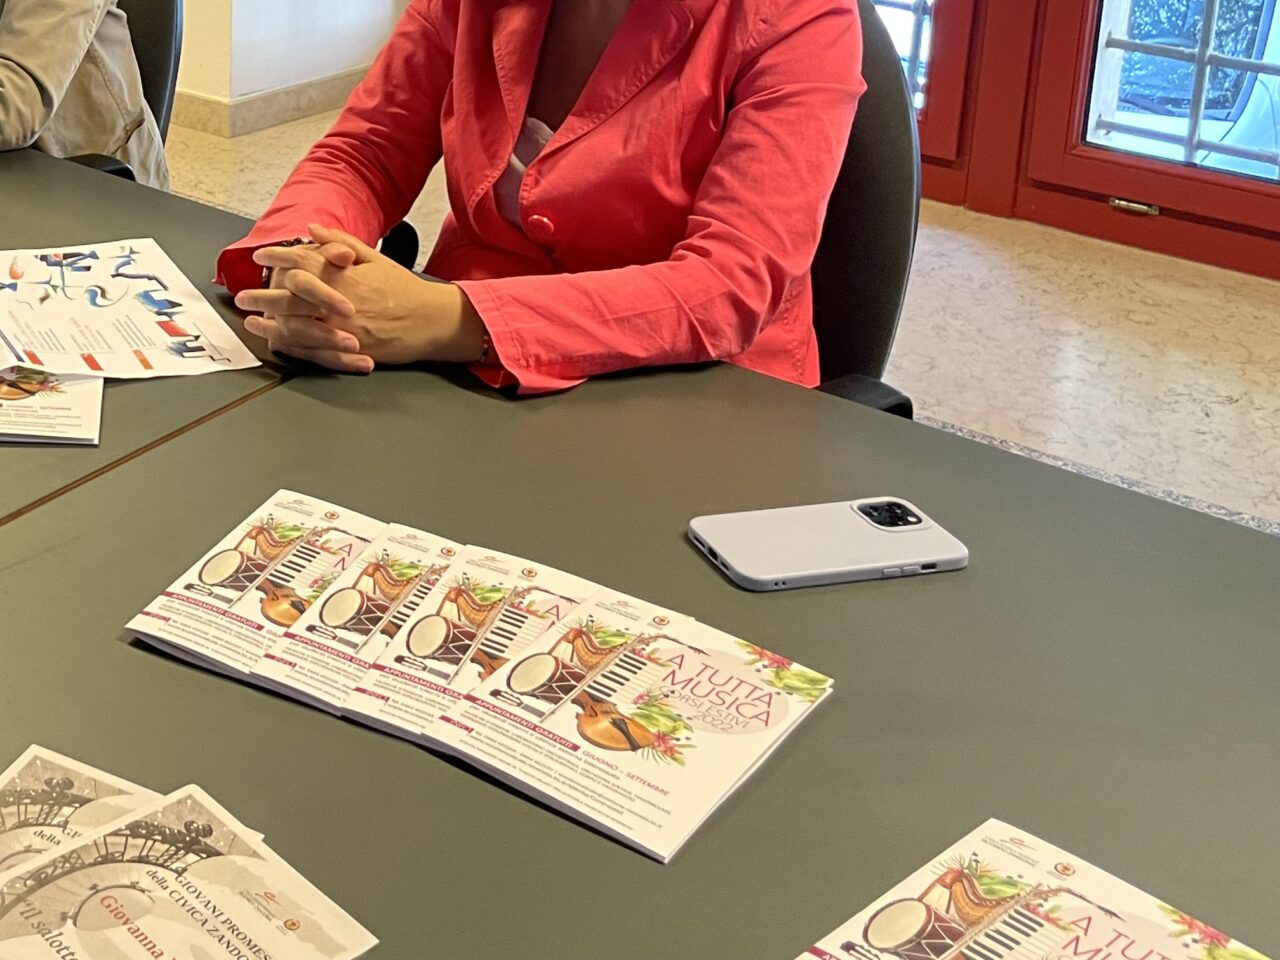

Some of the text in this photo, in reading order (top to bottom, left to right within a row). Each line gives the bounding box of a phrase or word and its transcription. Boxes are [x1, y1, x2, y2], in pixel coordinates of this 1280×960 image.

[340, 543, 352, 556] A
[171, 594, 224, 616] APPUNTAMENTI
[545, 604, 560, 620] A
[294, 635, 351, 662] APPUNTAMENTI
[383, 667, 445, 695] APPUNTAMENTI
[665, 654, 773, 709] A TUTTA
[661, 686, 751, 729] CORSI ESTIVI
[662, 669, 770, 727] MUSICA
[692, 710, 734, 732] 2022
[475, 700, 670, 796] APPUNTAMENTI GRATUITI GIUGNO SETTEMBRE
[33, 829, 61, 846] della
[146, 869, 170, 891] della
[169, 891, 209, 928] CIVICA
[175, 876, 224, 921] GIOVANI
[101, 895, 165, 959] Giovanna
[1070, 916, 1092, 936] A
